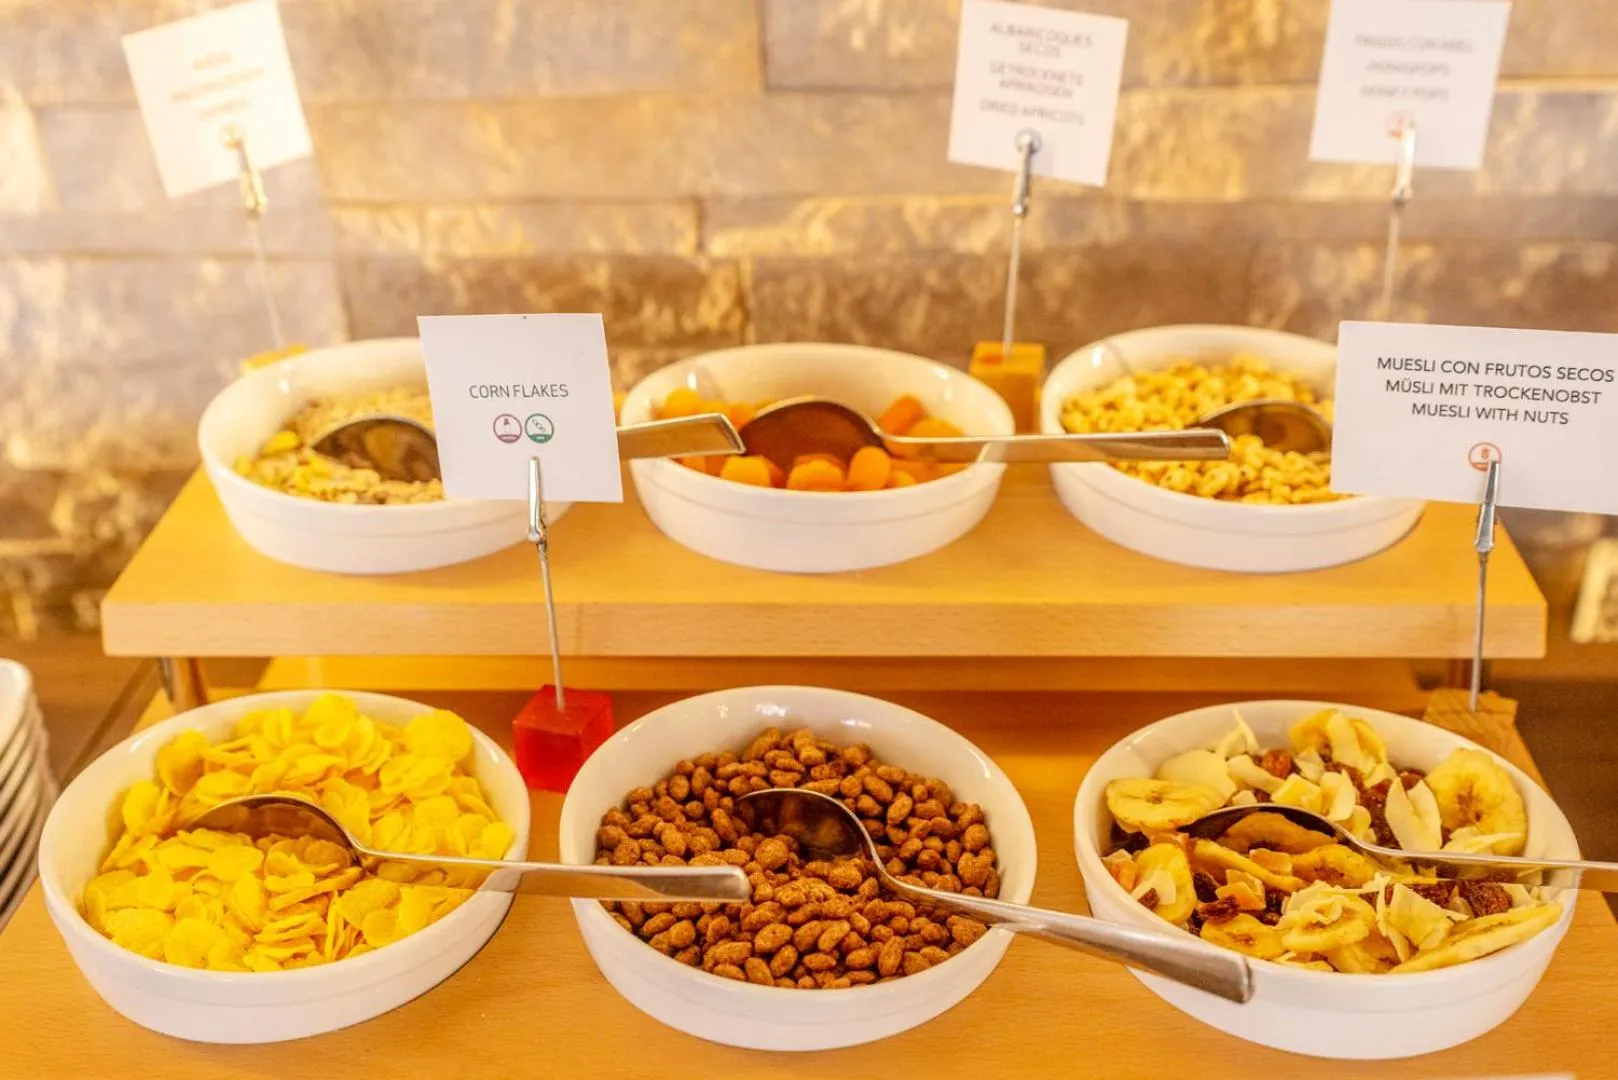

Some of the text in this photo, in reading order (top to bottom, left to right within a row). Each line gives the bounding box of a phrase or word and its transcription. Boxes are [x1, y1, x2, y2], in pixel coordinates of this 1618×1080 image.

[1377, 357, 1615, 382] MUESLI CON FRUTOS SECOS
[469, 383, 569, 399] CORN FLAKES
[1385, 377, 1602, 404] MÜSLI MIT TROCKENOBST
[1411, 402, 1569, 425] MUESLI WITH NUTS
